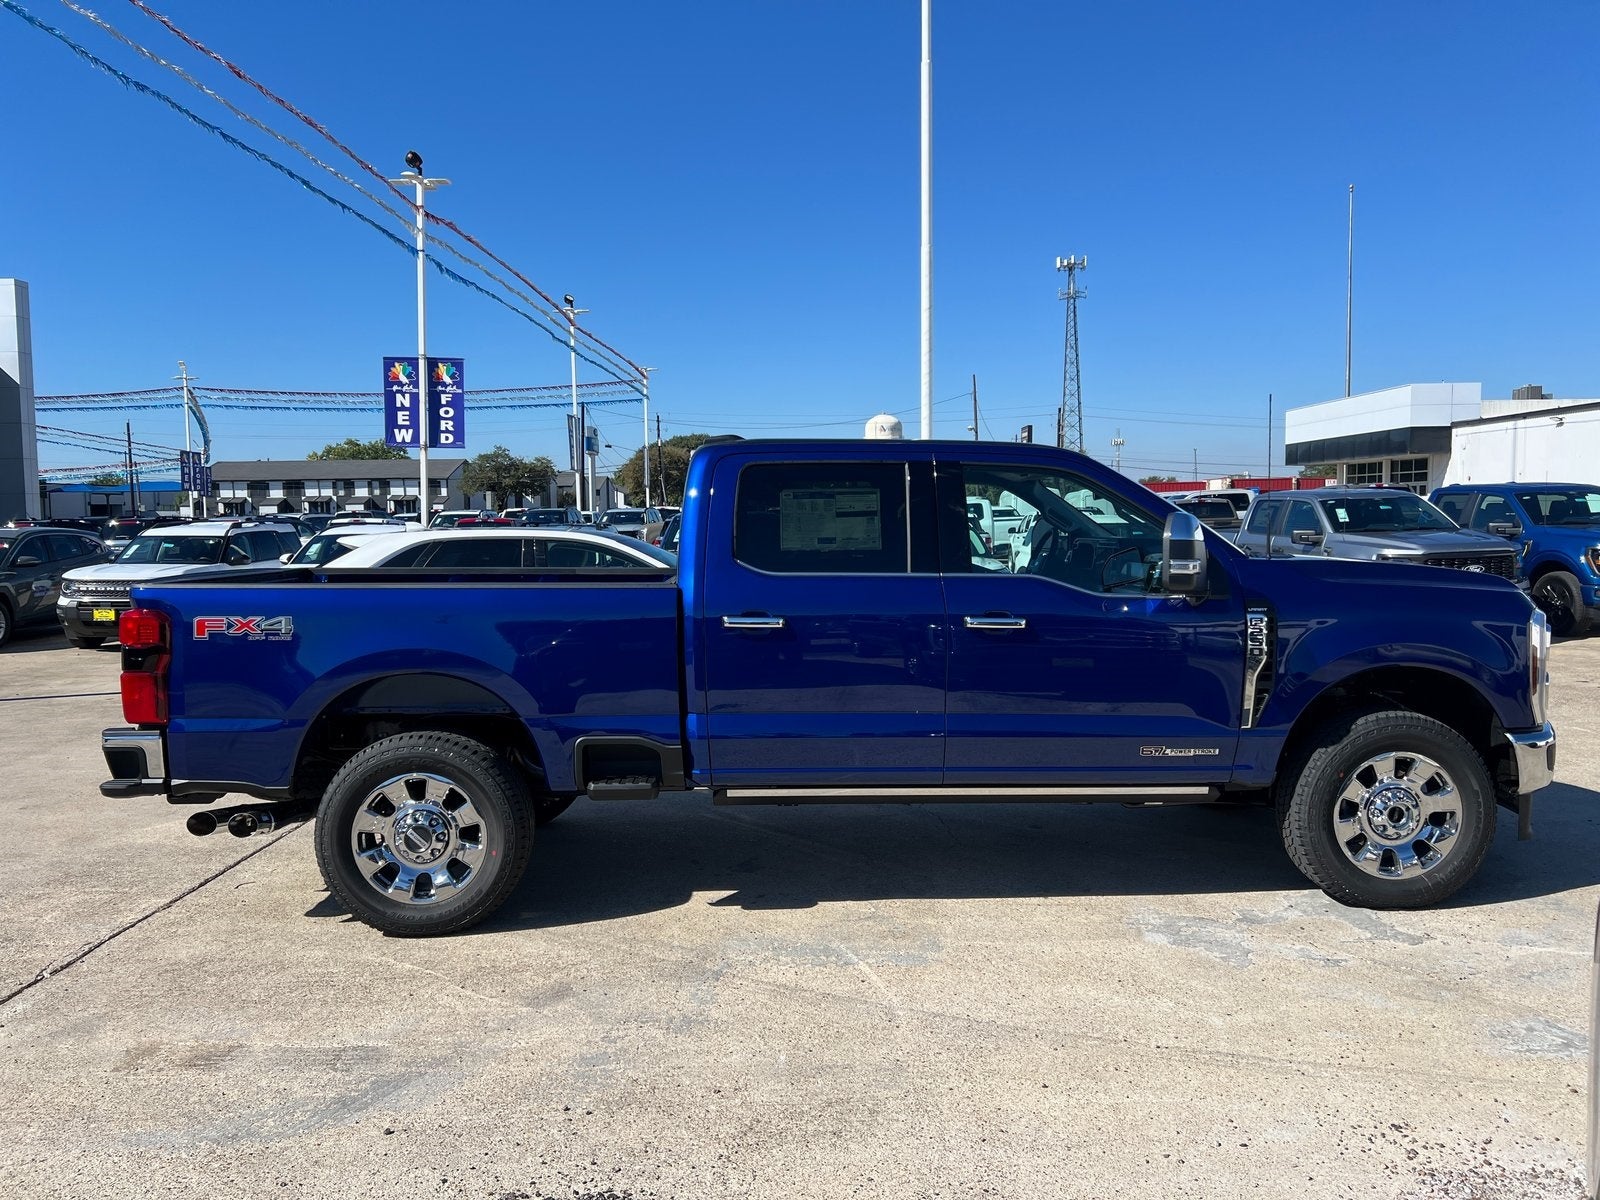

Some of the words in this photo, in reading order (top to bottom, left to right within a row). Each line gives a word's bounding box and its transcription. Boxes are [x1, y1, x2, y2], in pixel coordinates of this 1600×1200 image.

[393, 394, 413, 443] NEW
[439, 394, 455, 444] FORD
[193, 616, 294, 640] FX4
[1169, 748, 1192, 756] POWER
[1193, 748, 1217, 756] STROKE
